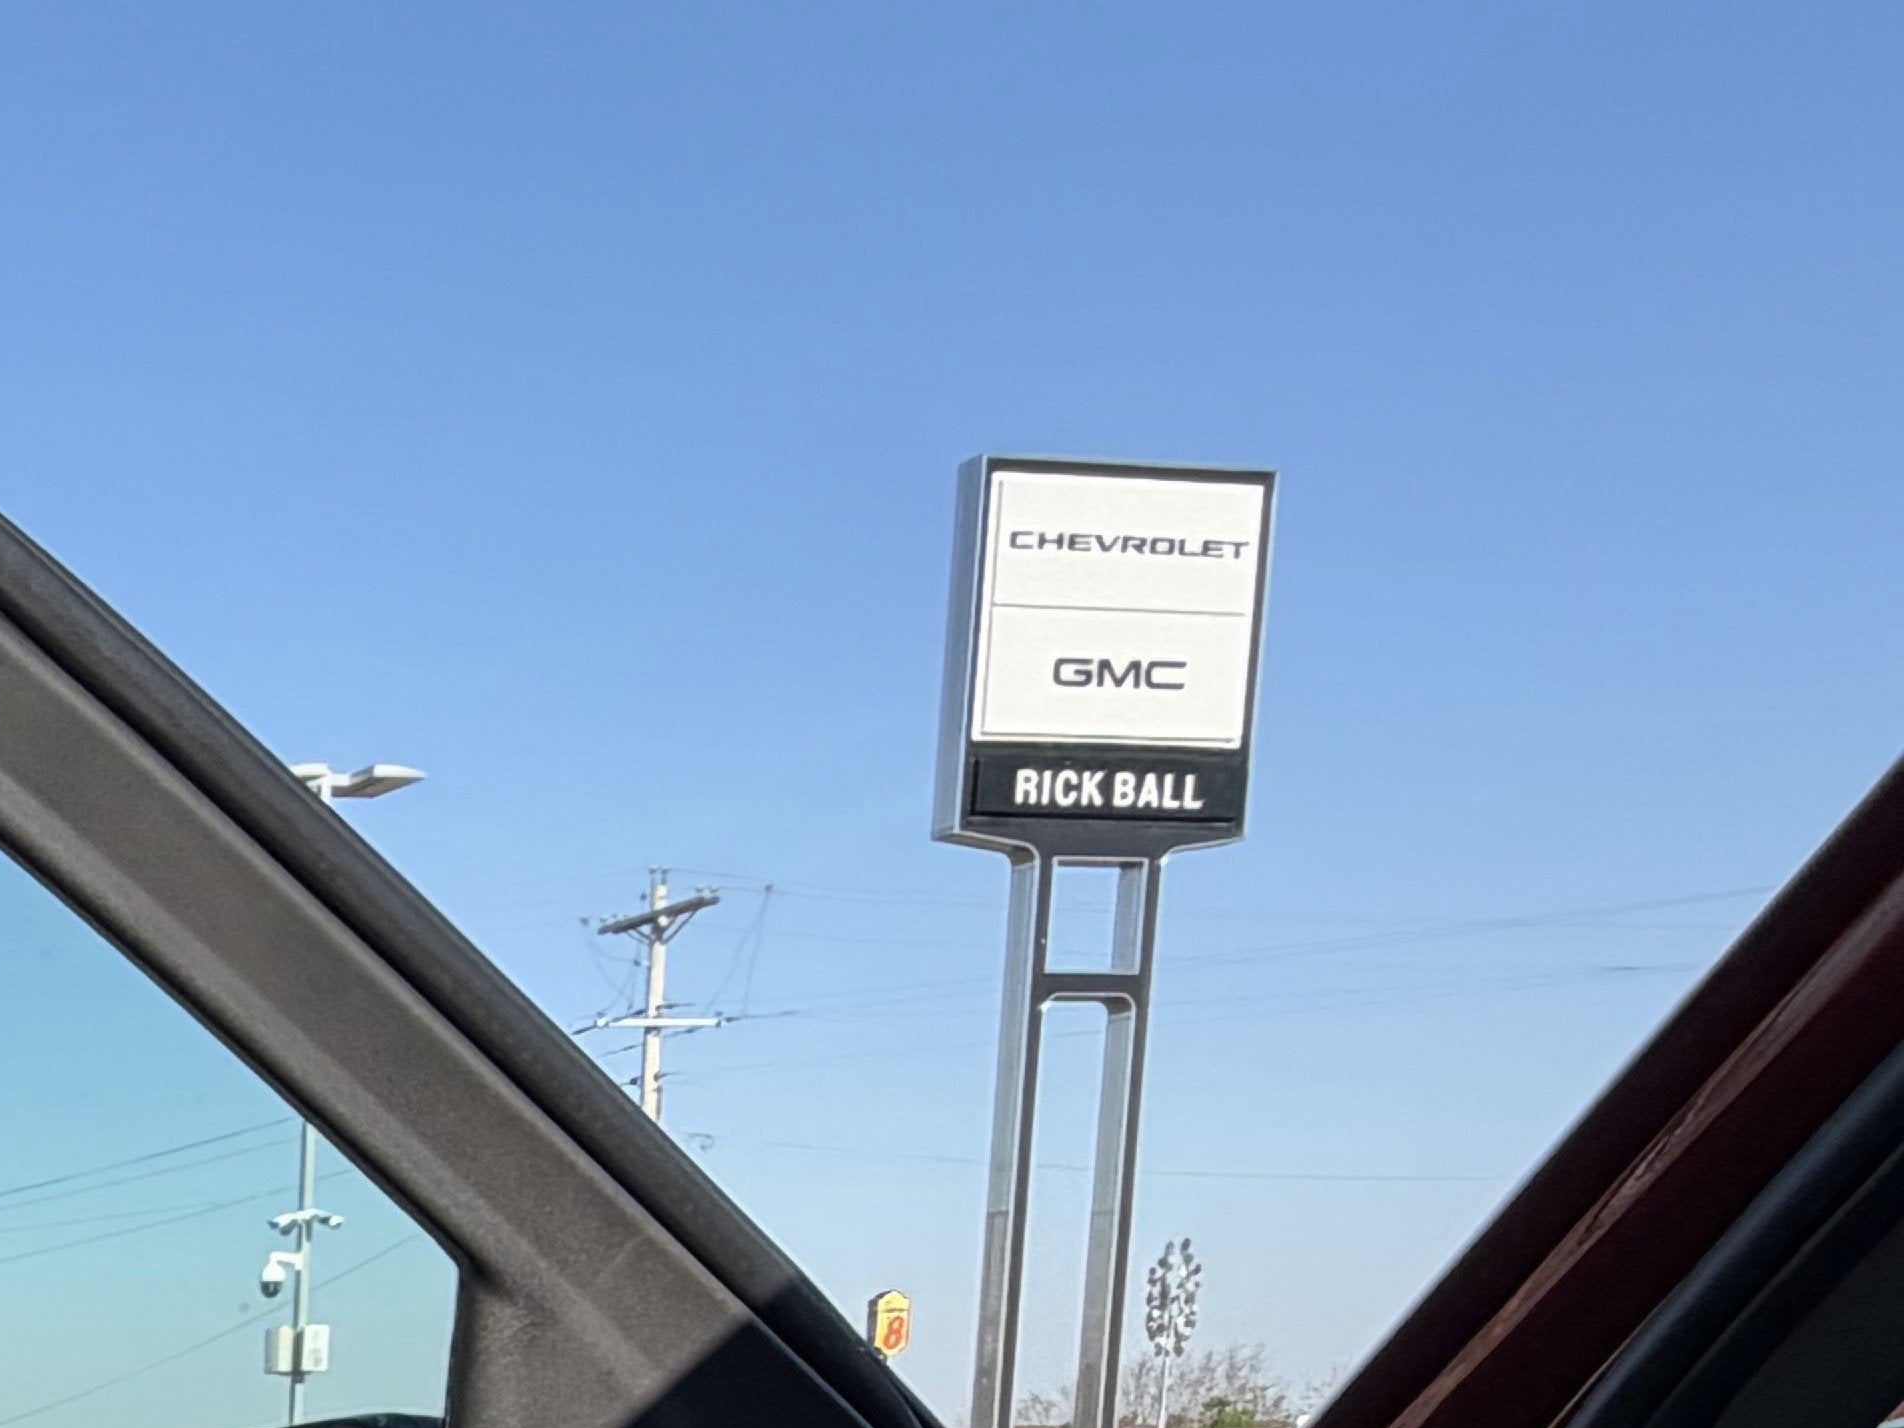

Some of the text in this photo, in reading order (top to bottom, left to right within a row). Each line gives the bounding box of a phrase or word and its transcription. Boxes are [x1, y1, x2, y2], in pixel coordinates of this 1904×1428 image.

[1010, 531, 1250, 560] CHEVROLET
[1053, 657, 1187, 690] GMC
[1014, 768, 1205, 810] RICK BALL
[883, 1315, 904, 1350] 8
